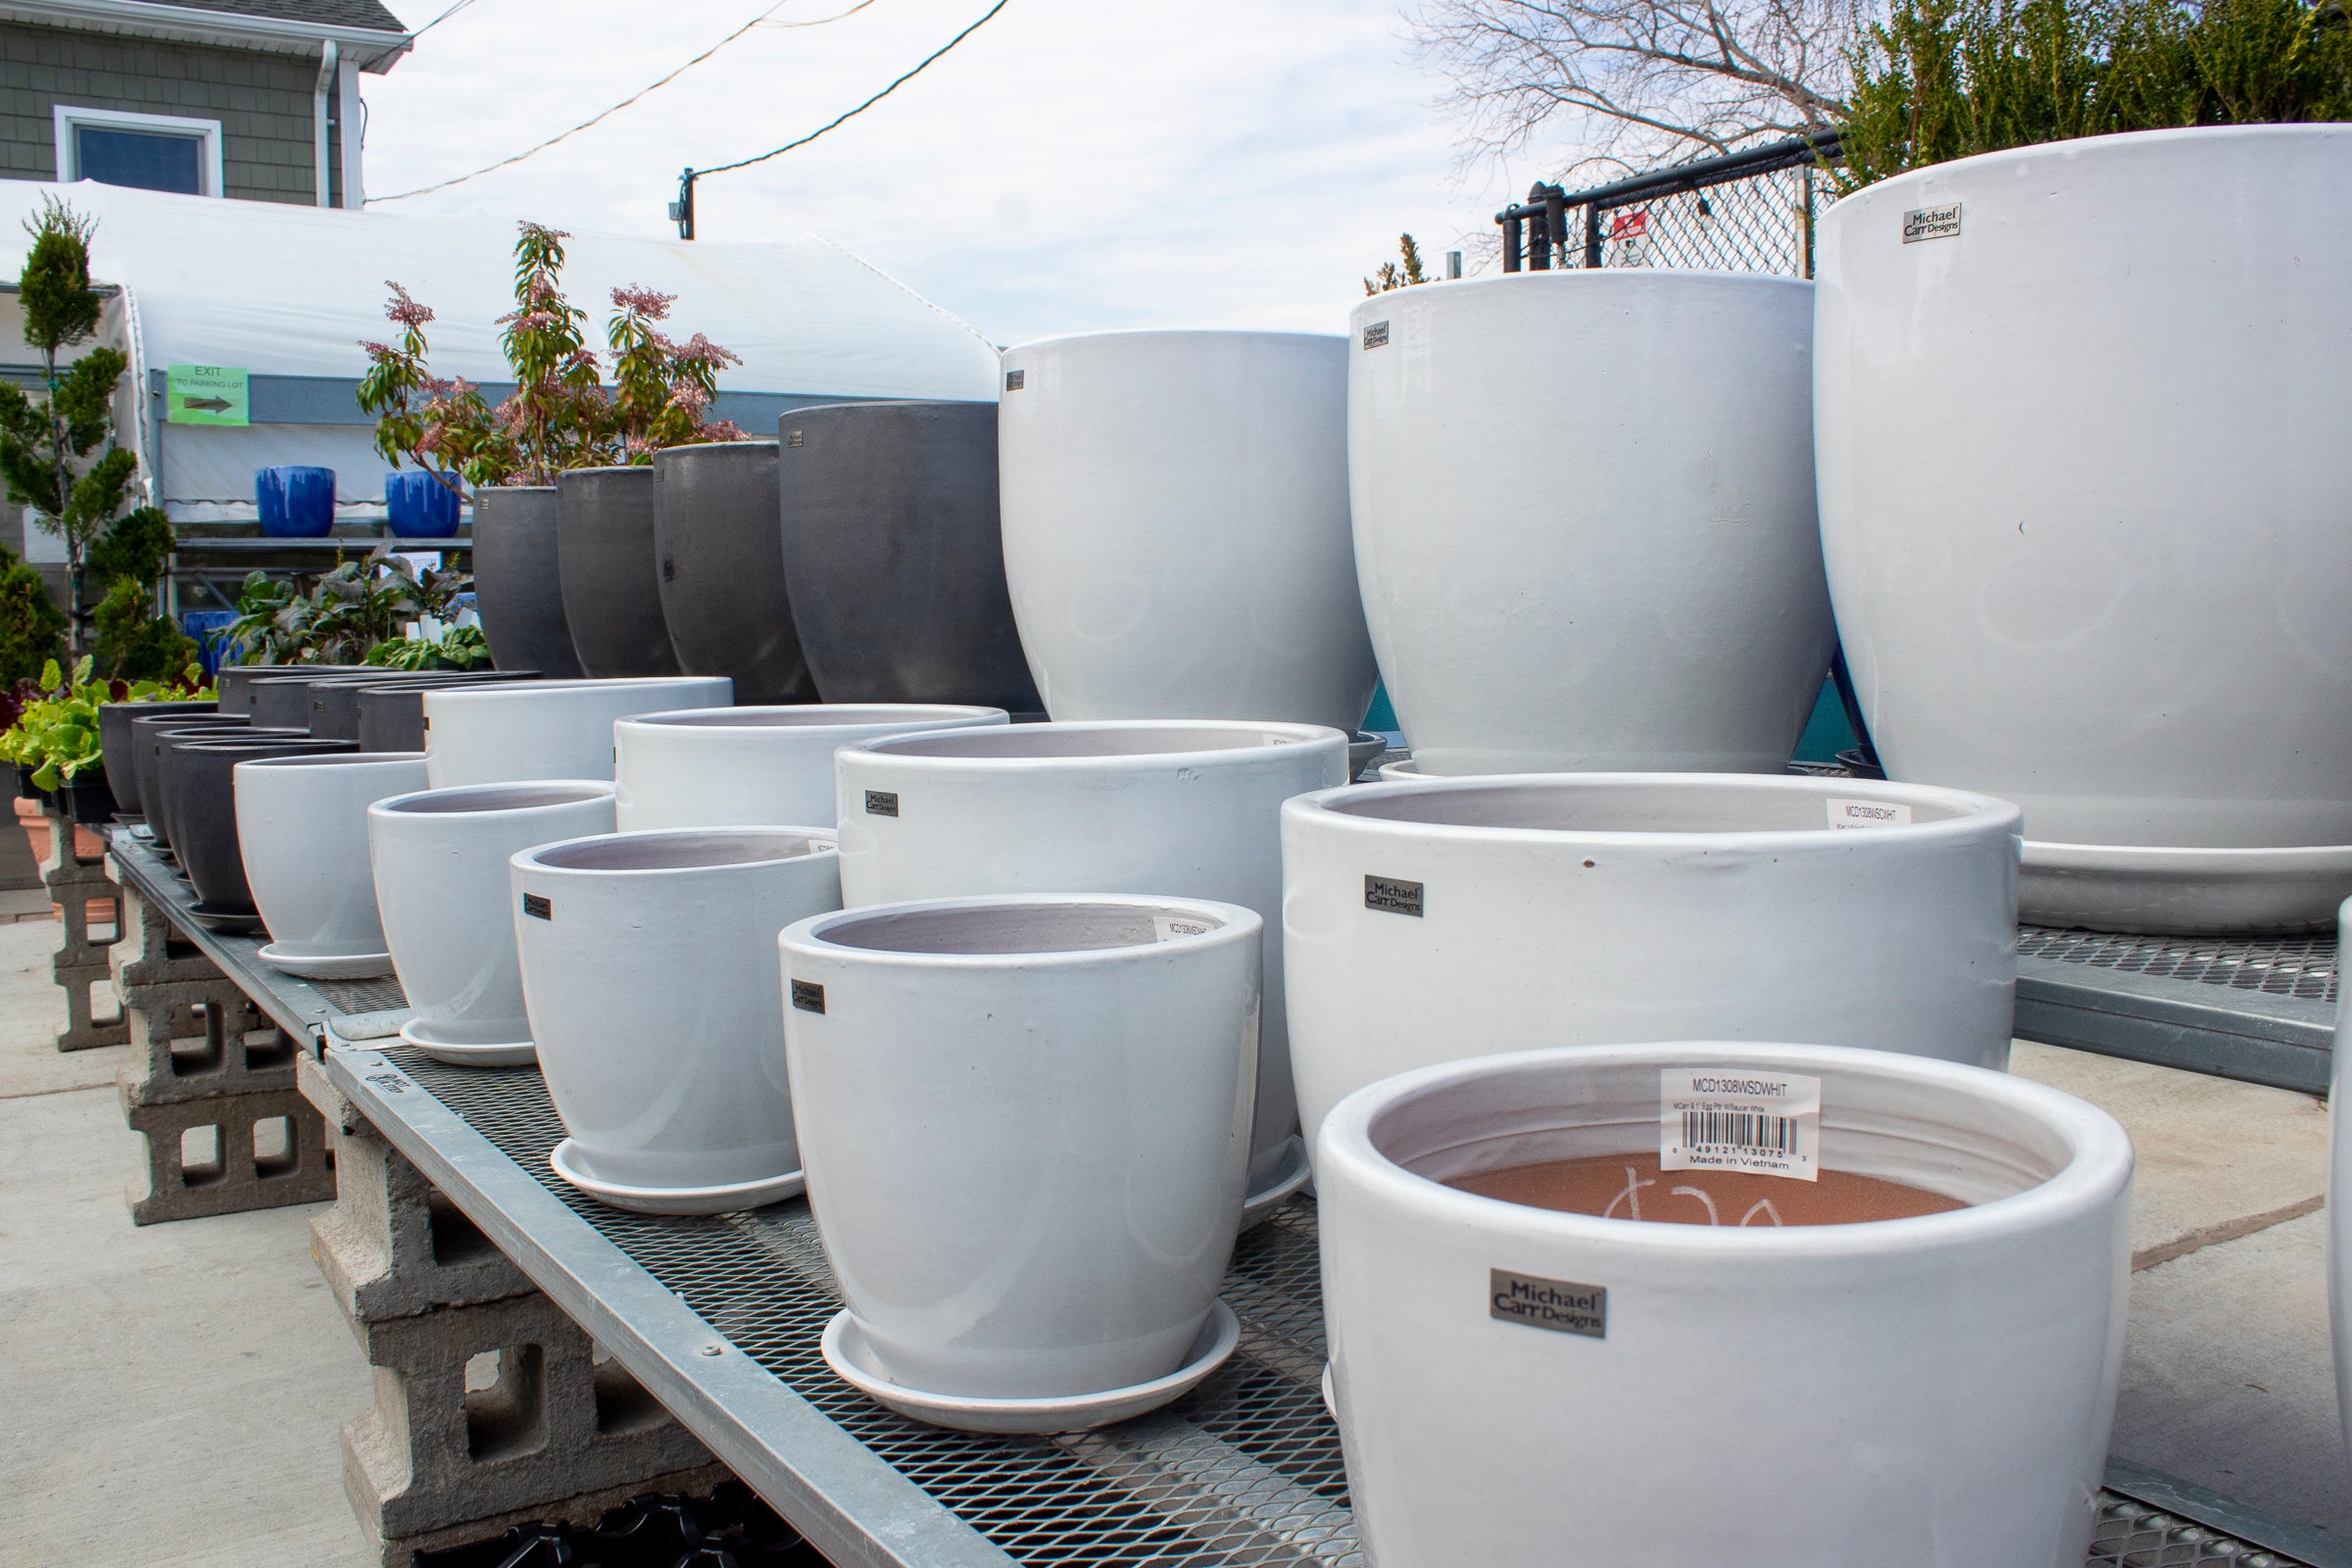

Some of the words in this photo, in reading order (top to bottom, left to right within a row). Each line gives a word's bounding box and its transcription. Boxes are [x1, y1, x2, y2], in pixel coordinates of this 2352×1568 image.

[1913, 207, 1956, 225] Michael
[1904, 224, 1927, 236] Carr
[1928, 221, 1958, 233] Designs
[195, 366, 221, 376] EXIT
[190, 379, 225, 389] PARKING
[870, 794, 896, 805] Michael
[1374, 882, 1418, 901] Michael
[1366, 891, 1390, 906] Carr
[1390, 898, 1421, 912] Designs
[1692, 1078, 1788, 1098] MCD1308WSDWHIT
[1701, 1102, 1713, 1111] Egg
[1690, 1155, 1723, 1164] Made
[1726, 1155, 1738, 1164] in
[1740, 1157, 1789, 1170] Vietnam
[1511, 1280, 1596, 1312] Michael
[1494, 1293, 1540, 1316] Carr
[1542, 1305, 1602, 1329] Designs
